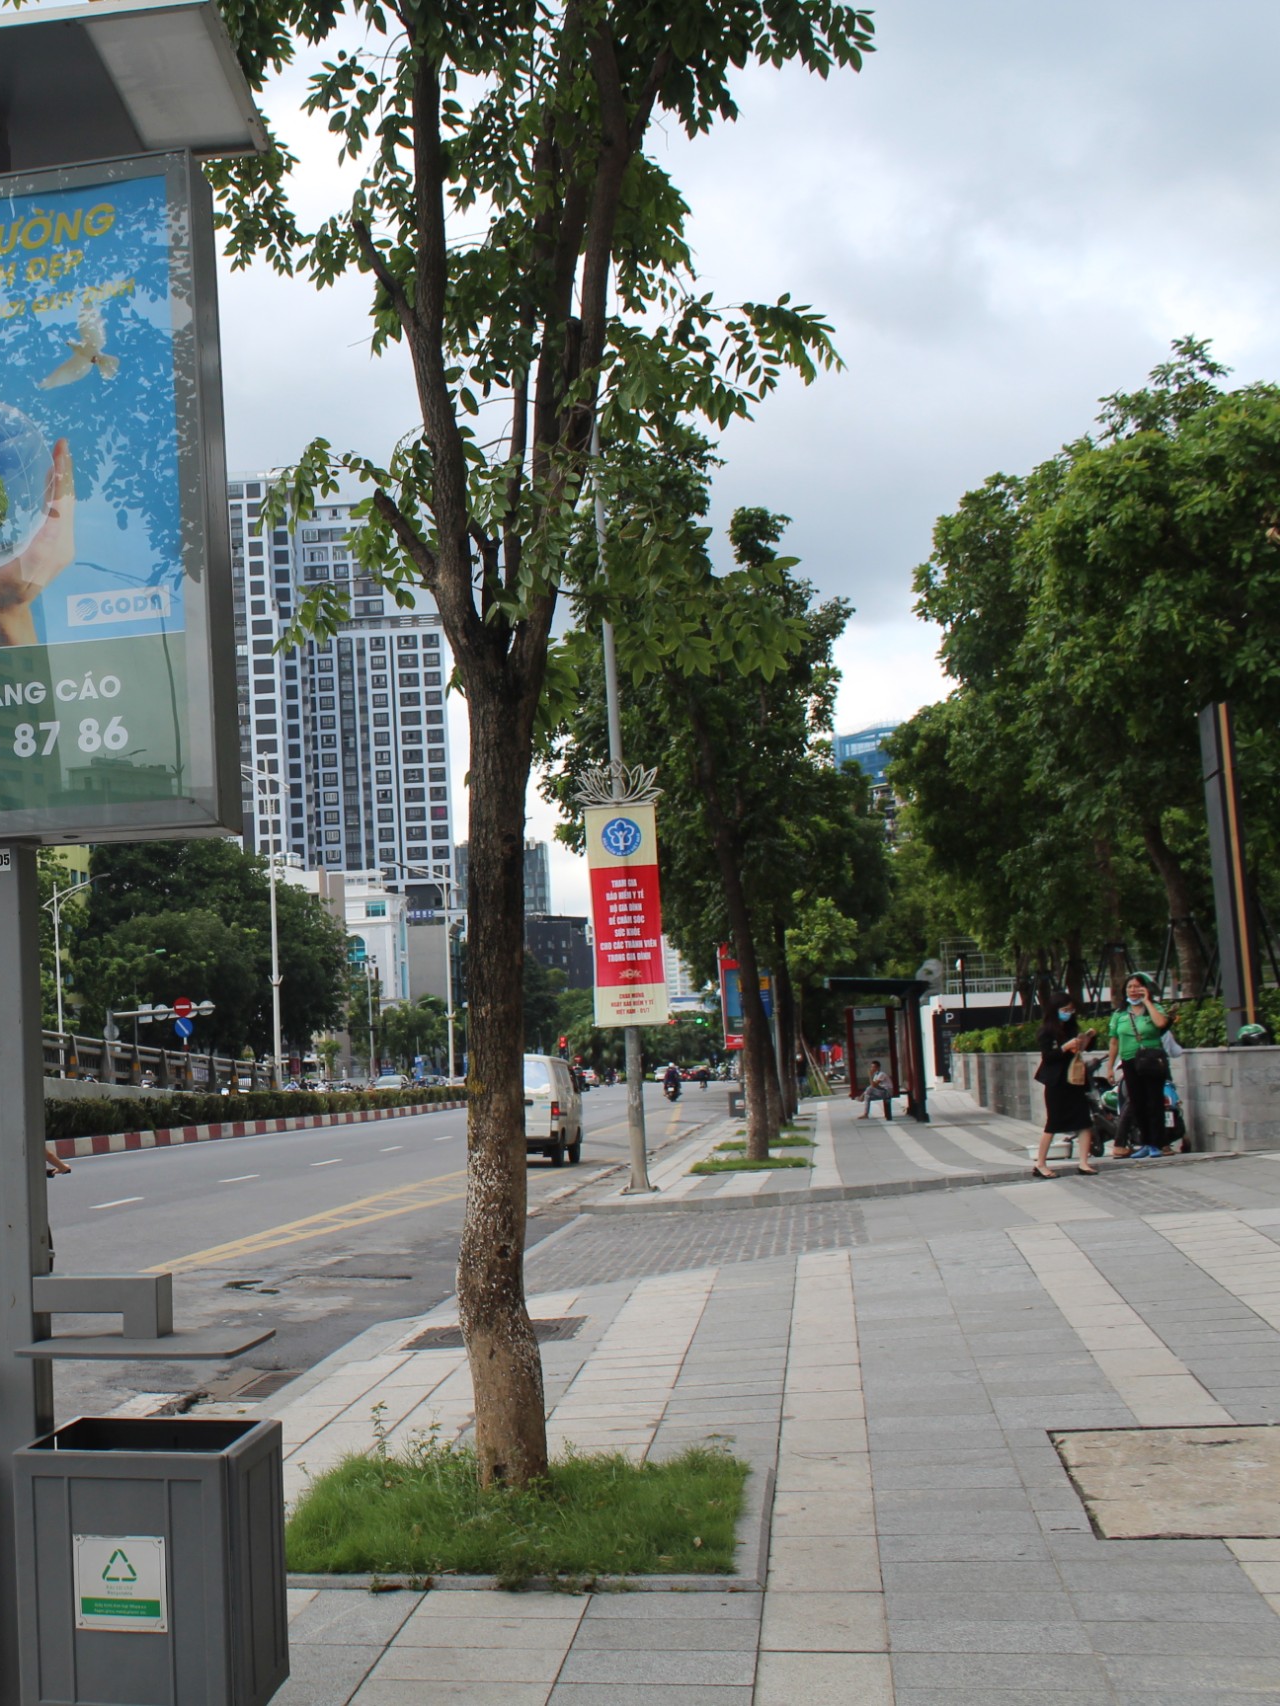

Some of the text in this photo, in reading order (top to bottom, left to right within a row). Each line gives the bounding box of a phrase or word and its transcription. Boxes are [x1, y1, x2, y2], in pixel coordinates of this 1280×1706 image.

[26, 249, 83, 285] ĐẸP
[32, 291, 76, 313] QUY
[55, 670, 121, 702] CÁO
[13, 721, 60, 758] 87
[78, 715, 129, 753] 86
[945, 1012, 954, 1023] P
